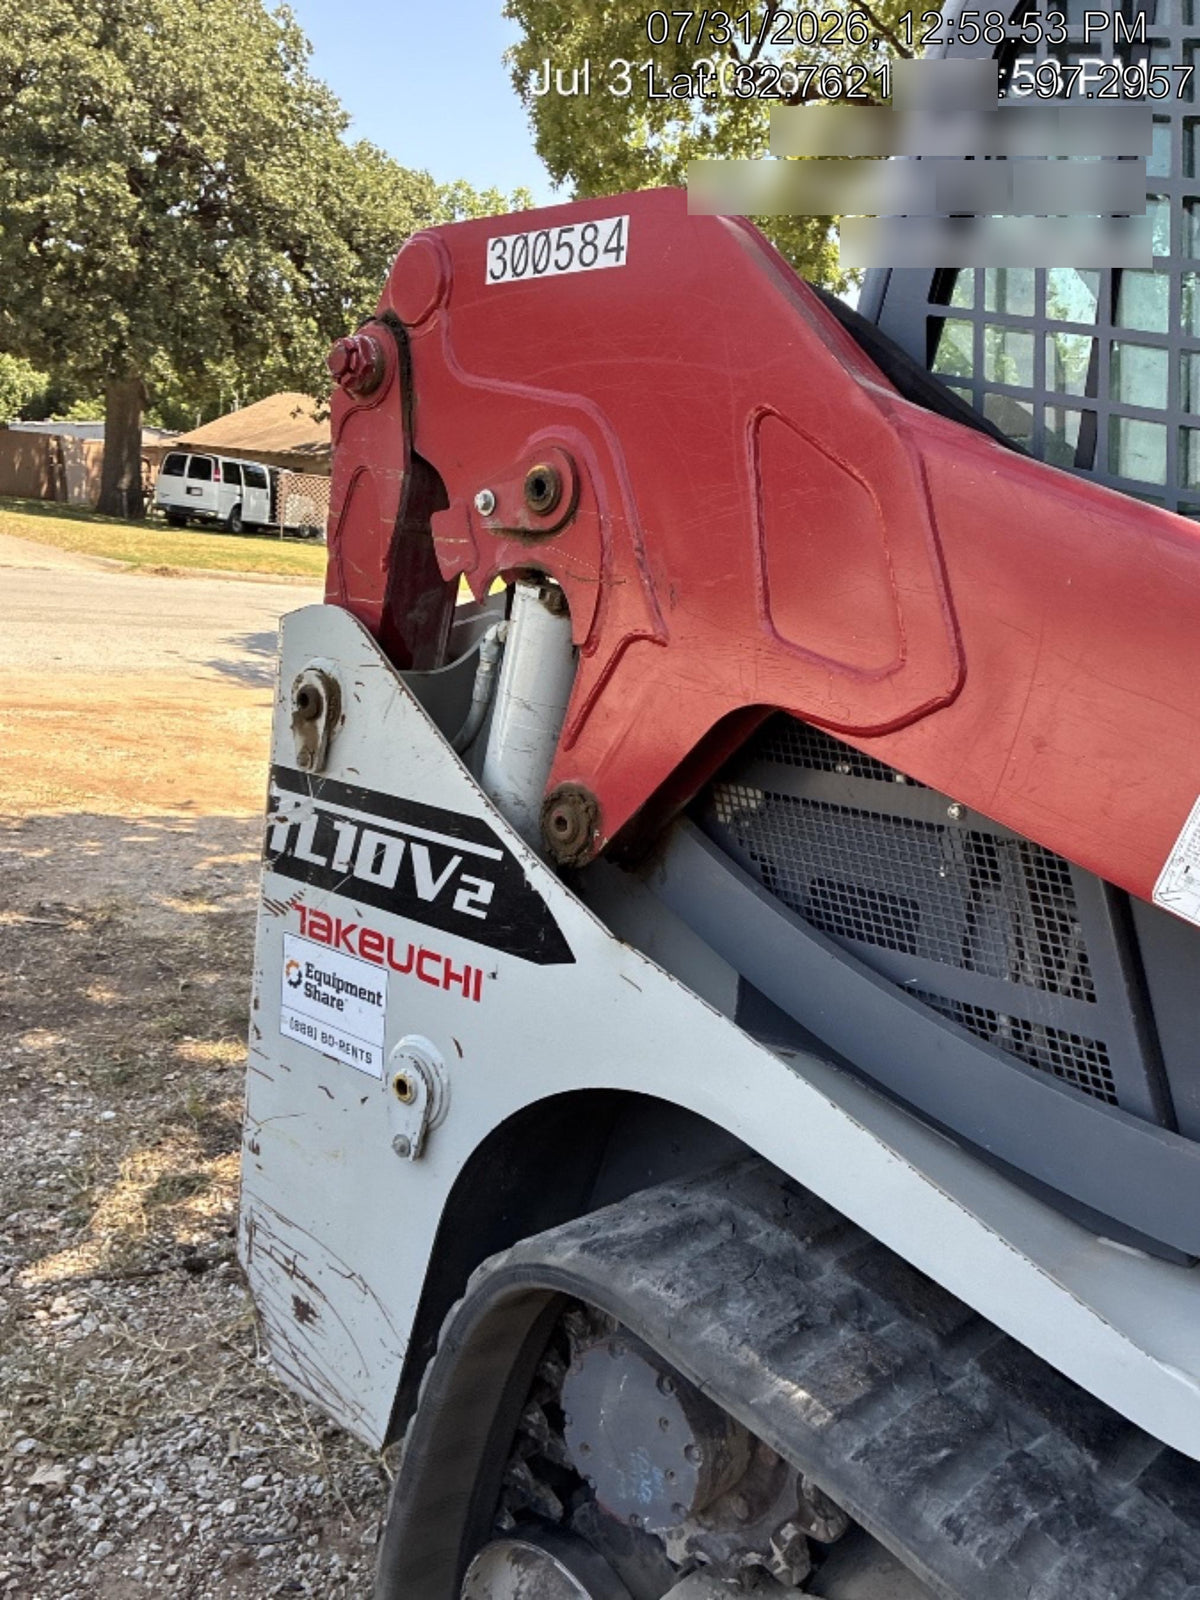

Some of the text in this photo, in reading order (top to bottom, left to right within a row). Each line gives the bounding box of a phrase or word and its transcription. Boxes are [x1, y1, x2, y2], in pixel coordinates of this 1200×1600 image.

[489, 217, 625, 281] 300584
[303, 982, 345, 1013] Share
[305, 961, 383, 1008] Equipment
